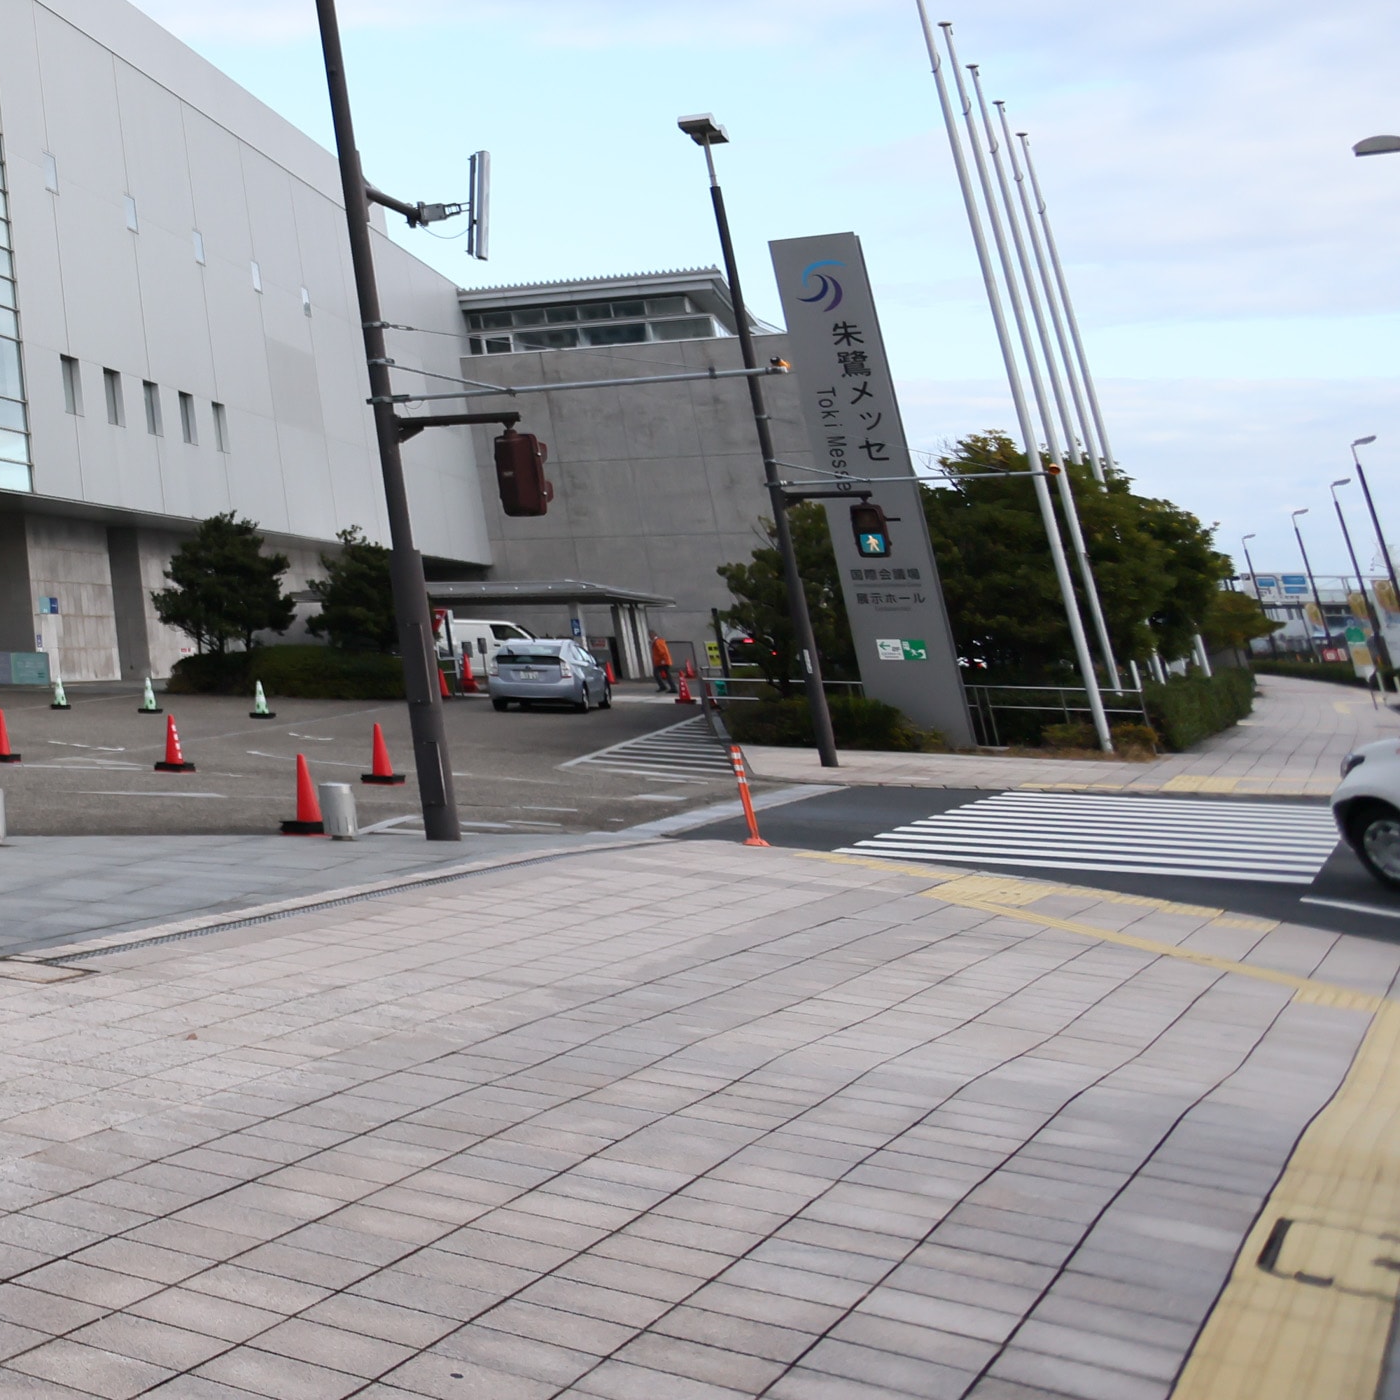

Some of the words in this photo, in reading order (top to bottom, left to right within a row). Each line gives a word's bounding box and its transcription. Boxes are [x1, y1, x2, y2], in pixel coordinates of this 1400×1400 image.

[816, 386, 843, 428] Toki
[832, 320, 891, 462] 朱鷺メッセ
[826, 435, 852, 492] Messe
[850, 567, 920, 581] 国際会議場
[856, 592, 926, 605] 展示ホール
